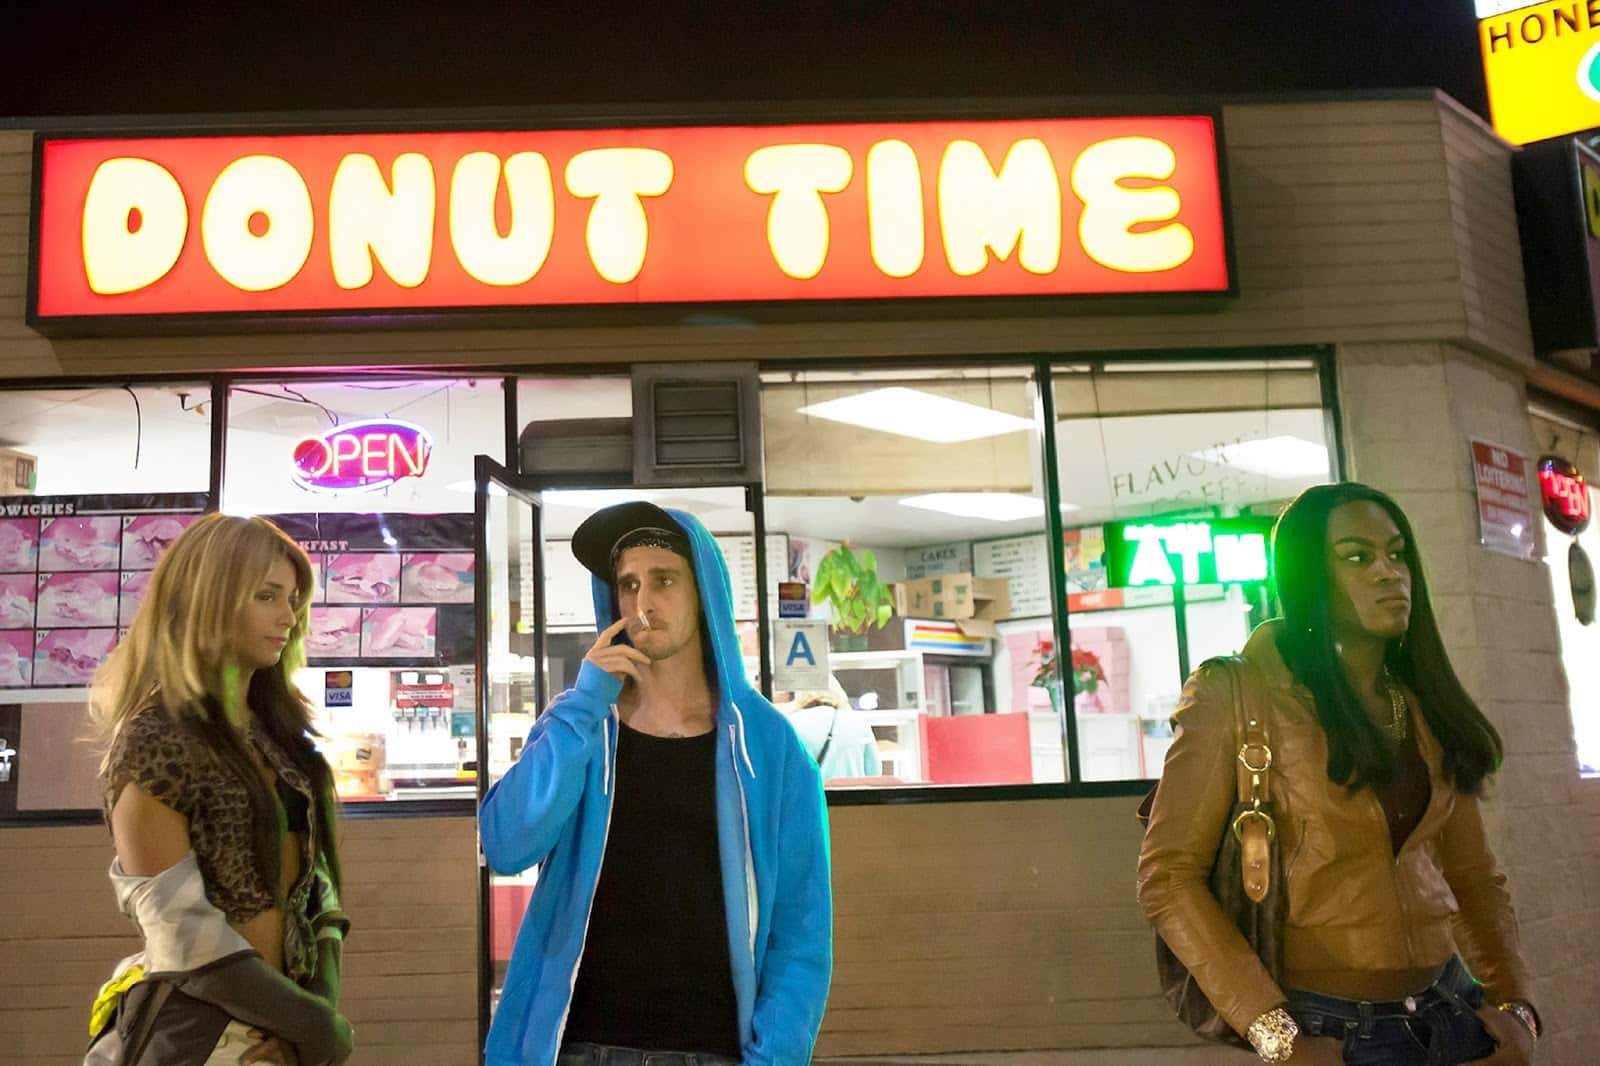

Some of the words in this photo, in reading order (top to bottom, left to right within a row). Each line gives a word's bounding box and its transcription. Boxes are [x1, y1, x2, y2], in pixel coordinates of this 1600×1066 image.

[82, 147, 675, 295] DONUT
[743, 136, 1195, 280] TIME
[290, 433, 425, 479] OPEN
[1491, 448, 1509, 468] NO
[1123, 522, 1268, 586] ATM
[783, 603, 805, 611] VISA
[786, 631, 816, 666] A
[329, 692, 352, 701] VISA
